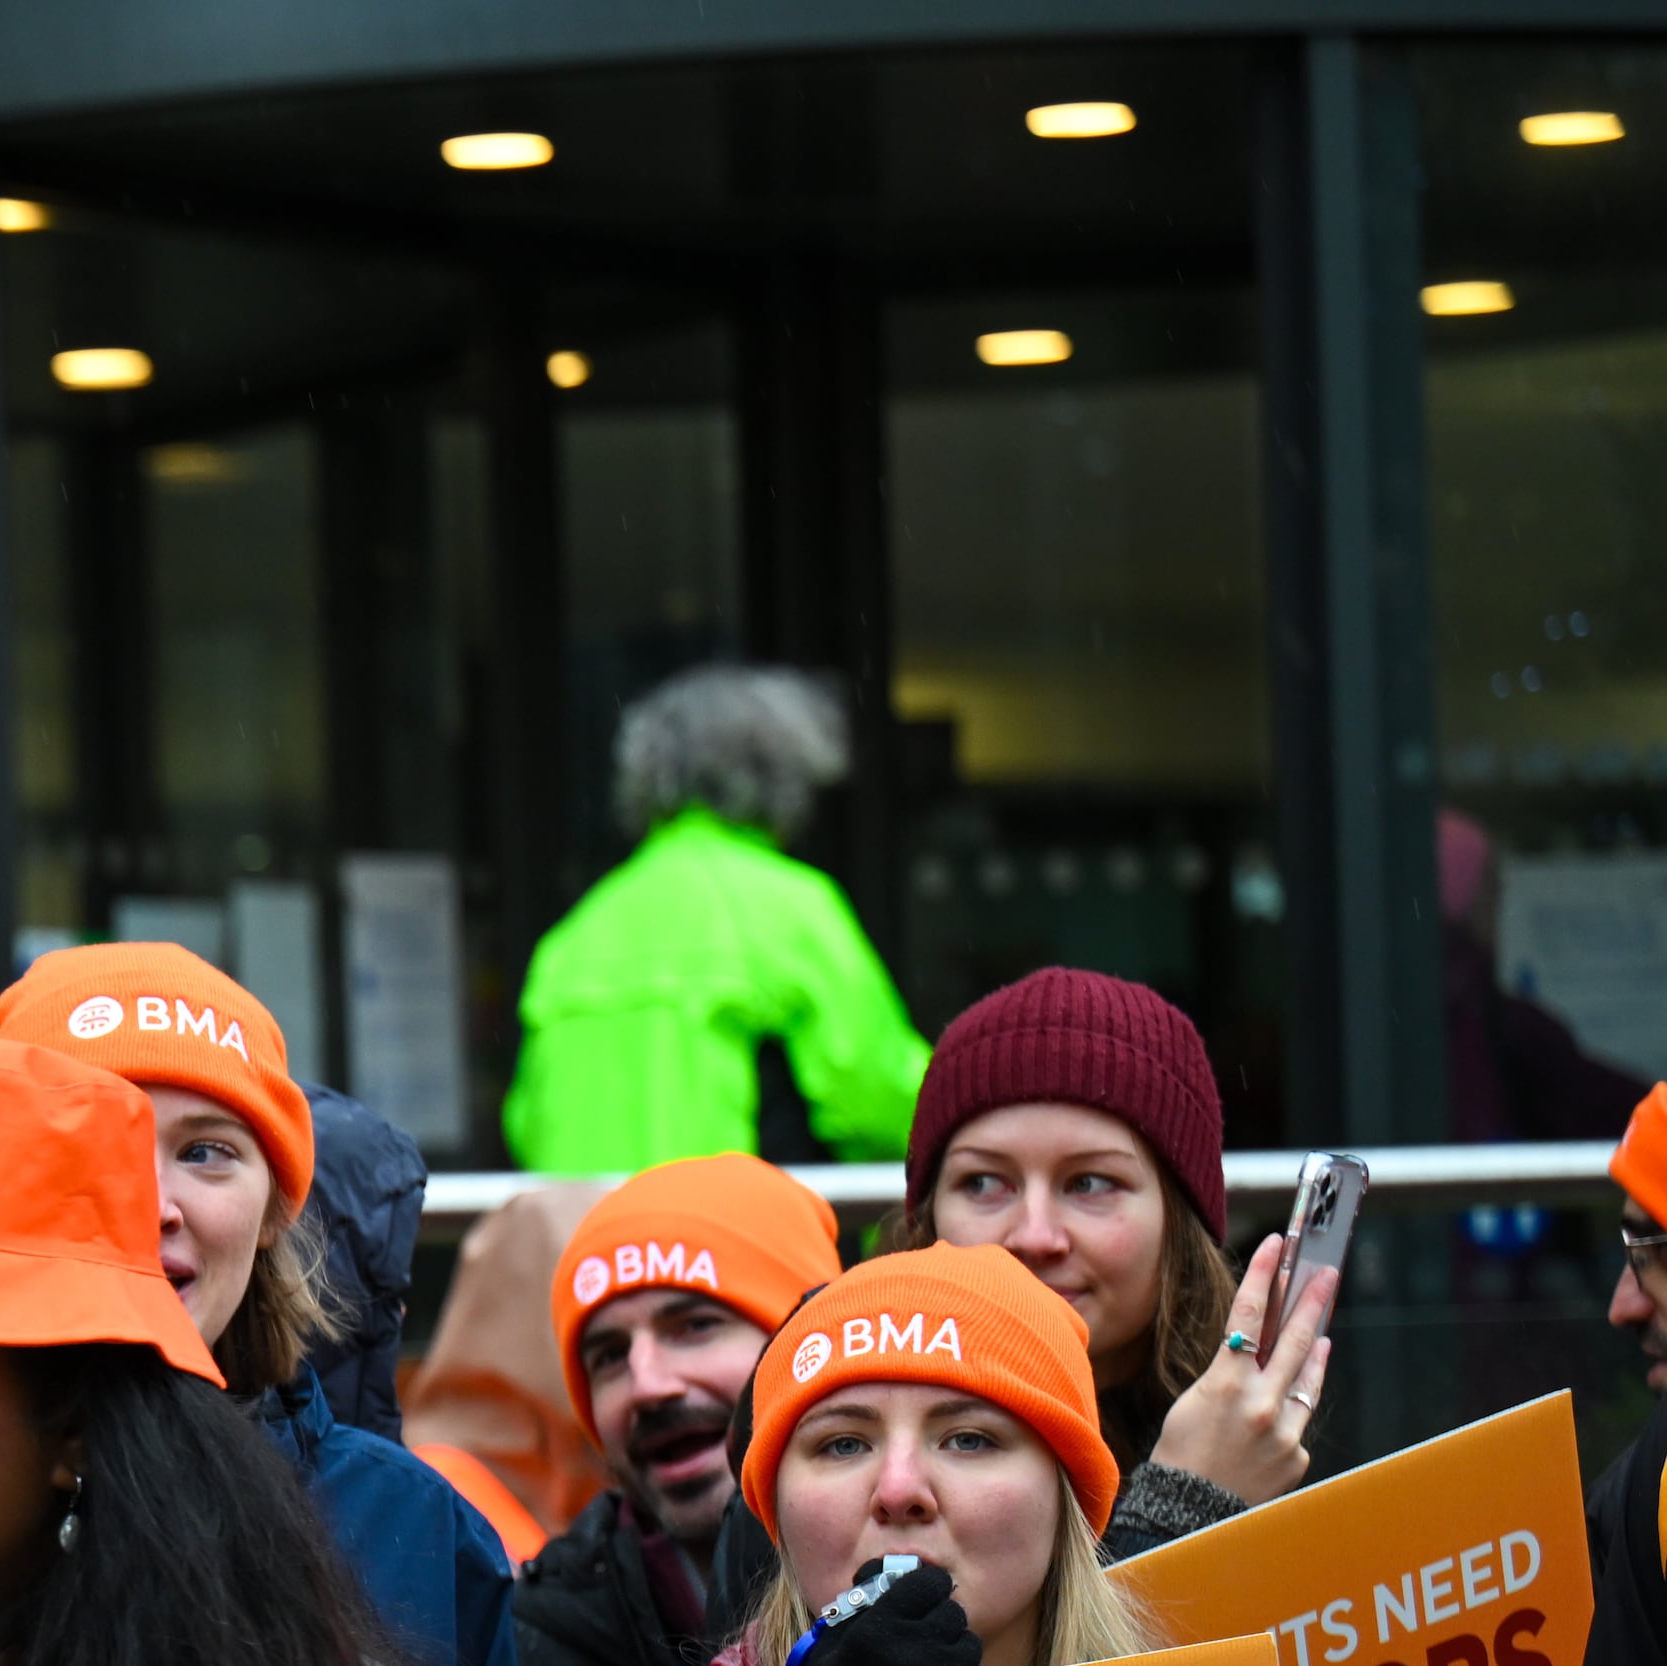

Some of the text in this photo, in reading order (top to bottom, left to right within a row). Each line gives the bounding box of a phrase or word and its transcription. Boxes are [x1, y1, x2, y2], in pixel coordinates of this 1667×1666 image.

[137, 996, 248, 1062] BMA
[616, 1241, 718, 1289] BMA
[842, 1313, 961, 1361] BMA
[1374, 1531, 1540, 1641] NEED
